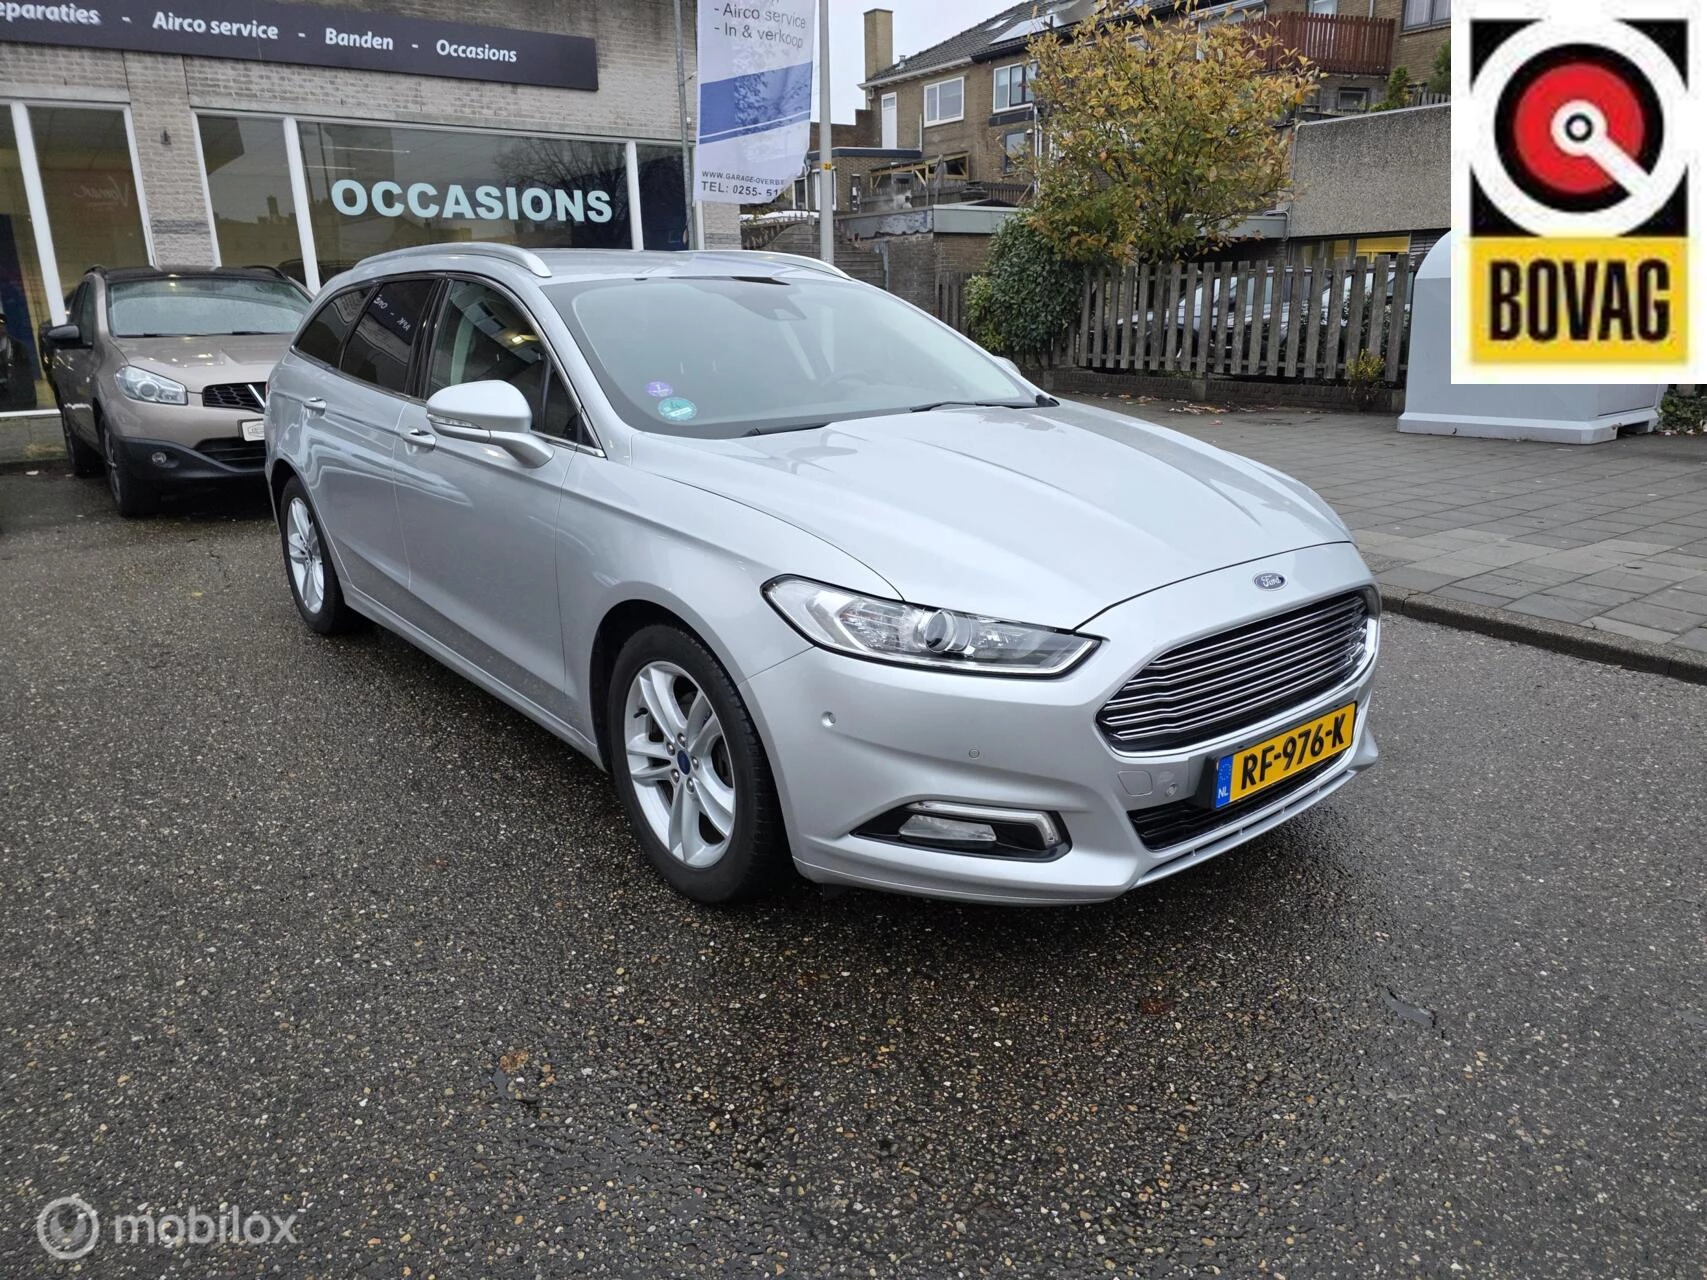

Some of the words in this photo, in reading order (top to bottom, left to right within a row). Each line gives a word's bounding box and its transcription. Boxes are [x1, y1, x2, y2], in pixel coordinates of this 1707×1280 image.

[723, 2, 760, 20] Airco
[764, 10, 806, 29] service
[152, 11, 207, 33] Airco
[210, 19, 279, 40] service
[325, 27, 394, 50] Banden
[436, 39, 518, 62] Occasions
[724, 22, 737, 37] In
[742, 24, 752, 39] &
[757, 29, 804, 49] verkoop
[701, 180, 729, 193] TEL:
[331, 179, 613, 223] OCCASIONS
[1261, 575, 1282, 587] Ford
[1240, 713, 1346, 790] RF-976-K
[1217, 786, 1229, 799] NL
